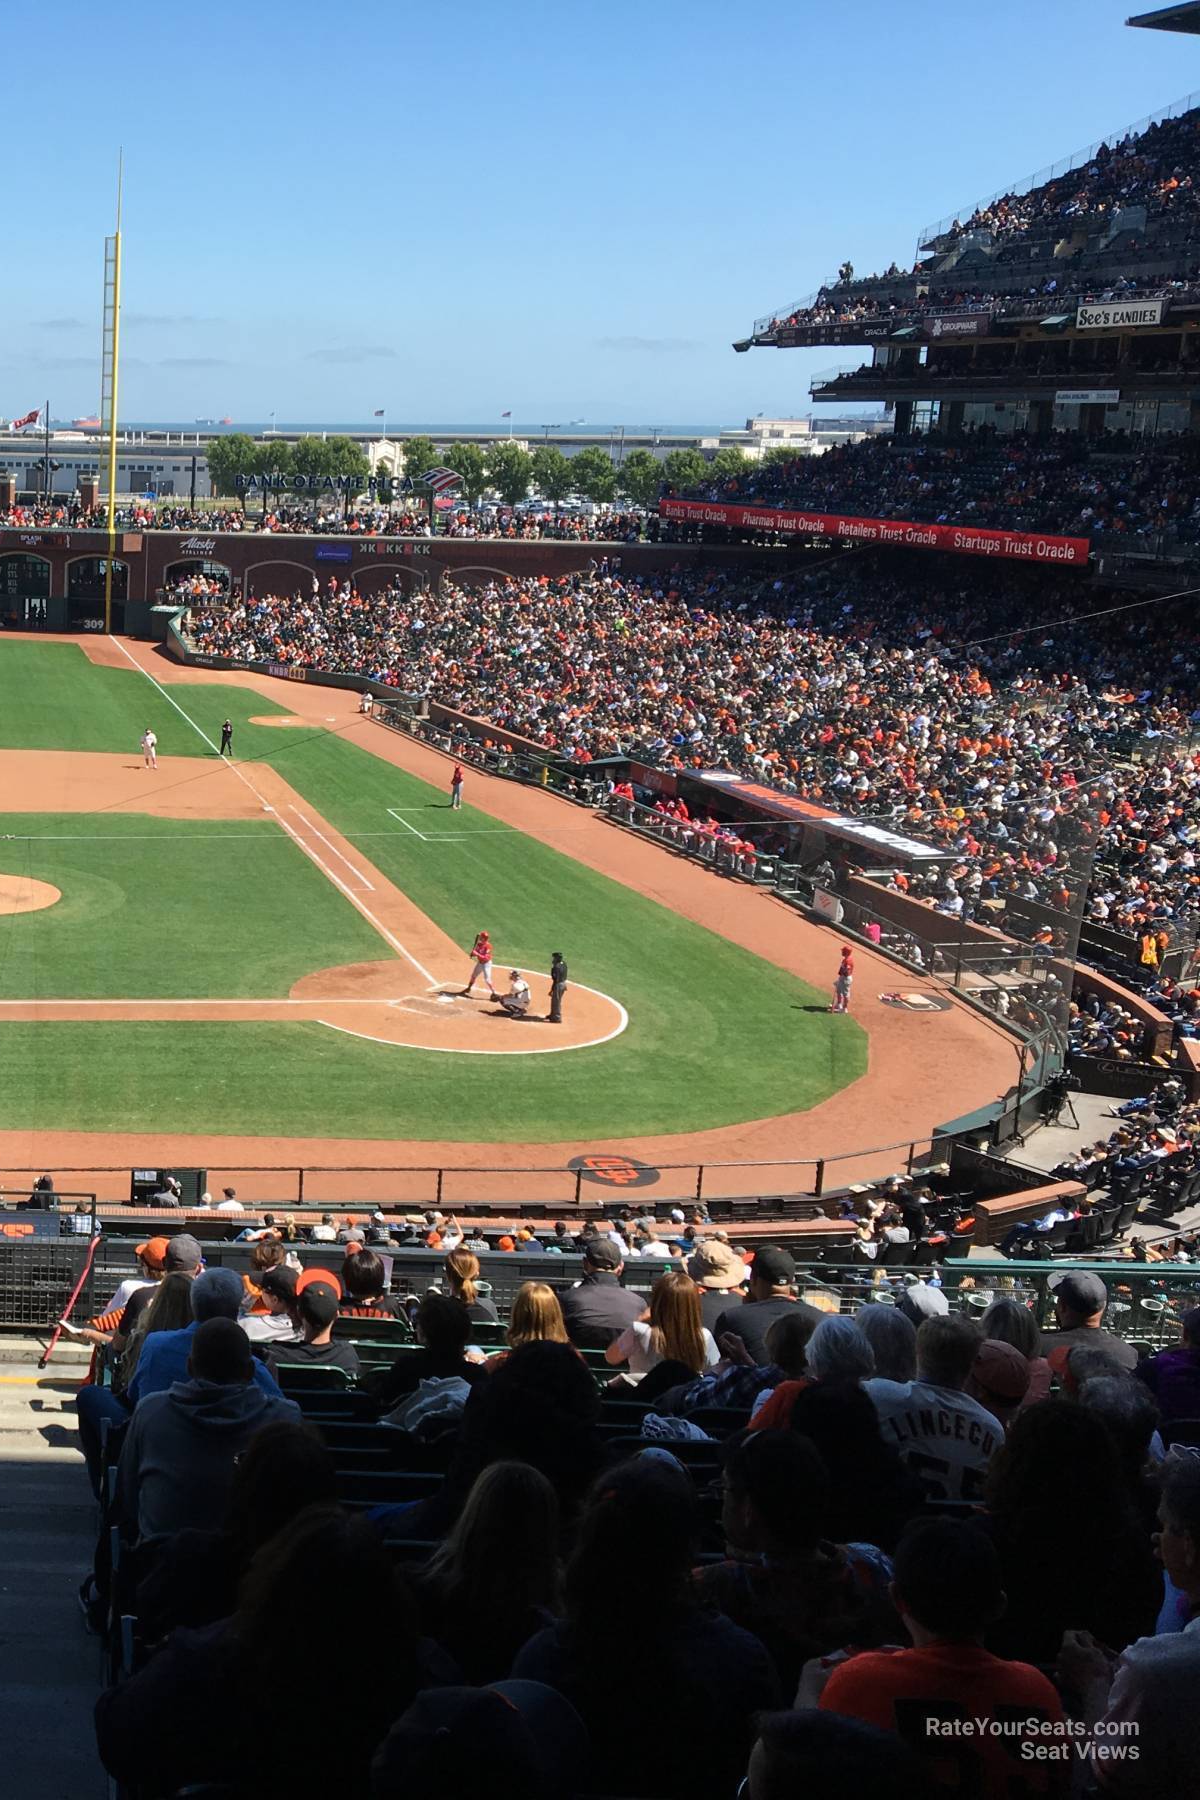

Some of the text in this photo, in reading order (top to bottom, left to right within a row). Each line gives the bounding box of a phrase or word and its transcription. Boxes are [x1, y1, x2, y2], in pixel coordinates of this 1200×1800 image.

[1078, 308, 1157, 326] See's CANDIES
[864, 328, 888, 337] ORACLE
[942, 321, 978, 331] GROUPWARE
[235, 473, 414, 490] BANK OF AMERICA
[20, 534, 42, 542] SPLASH
[665, 504, 1075, 560] Banks Trust Oracle Pharmas Trust Oracle Retailers Trust Oracle Startups Trust Oracle
[179, 537, 216, 550] Alaska
[84, 619, 104, 629] 309
[269, 665, 289, 678] KNBR
[1116, 1066, 1167, 1079] LEXUS
[992, 1163, 1040, 1186] LEXUS
[888, 1410, 996, 1456] LINCECU
